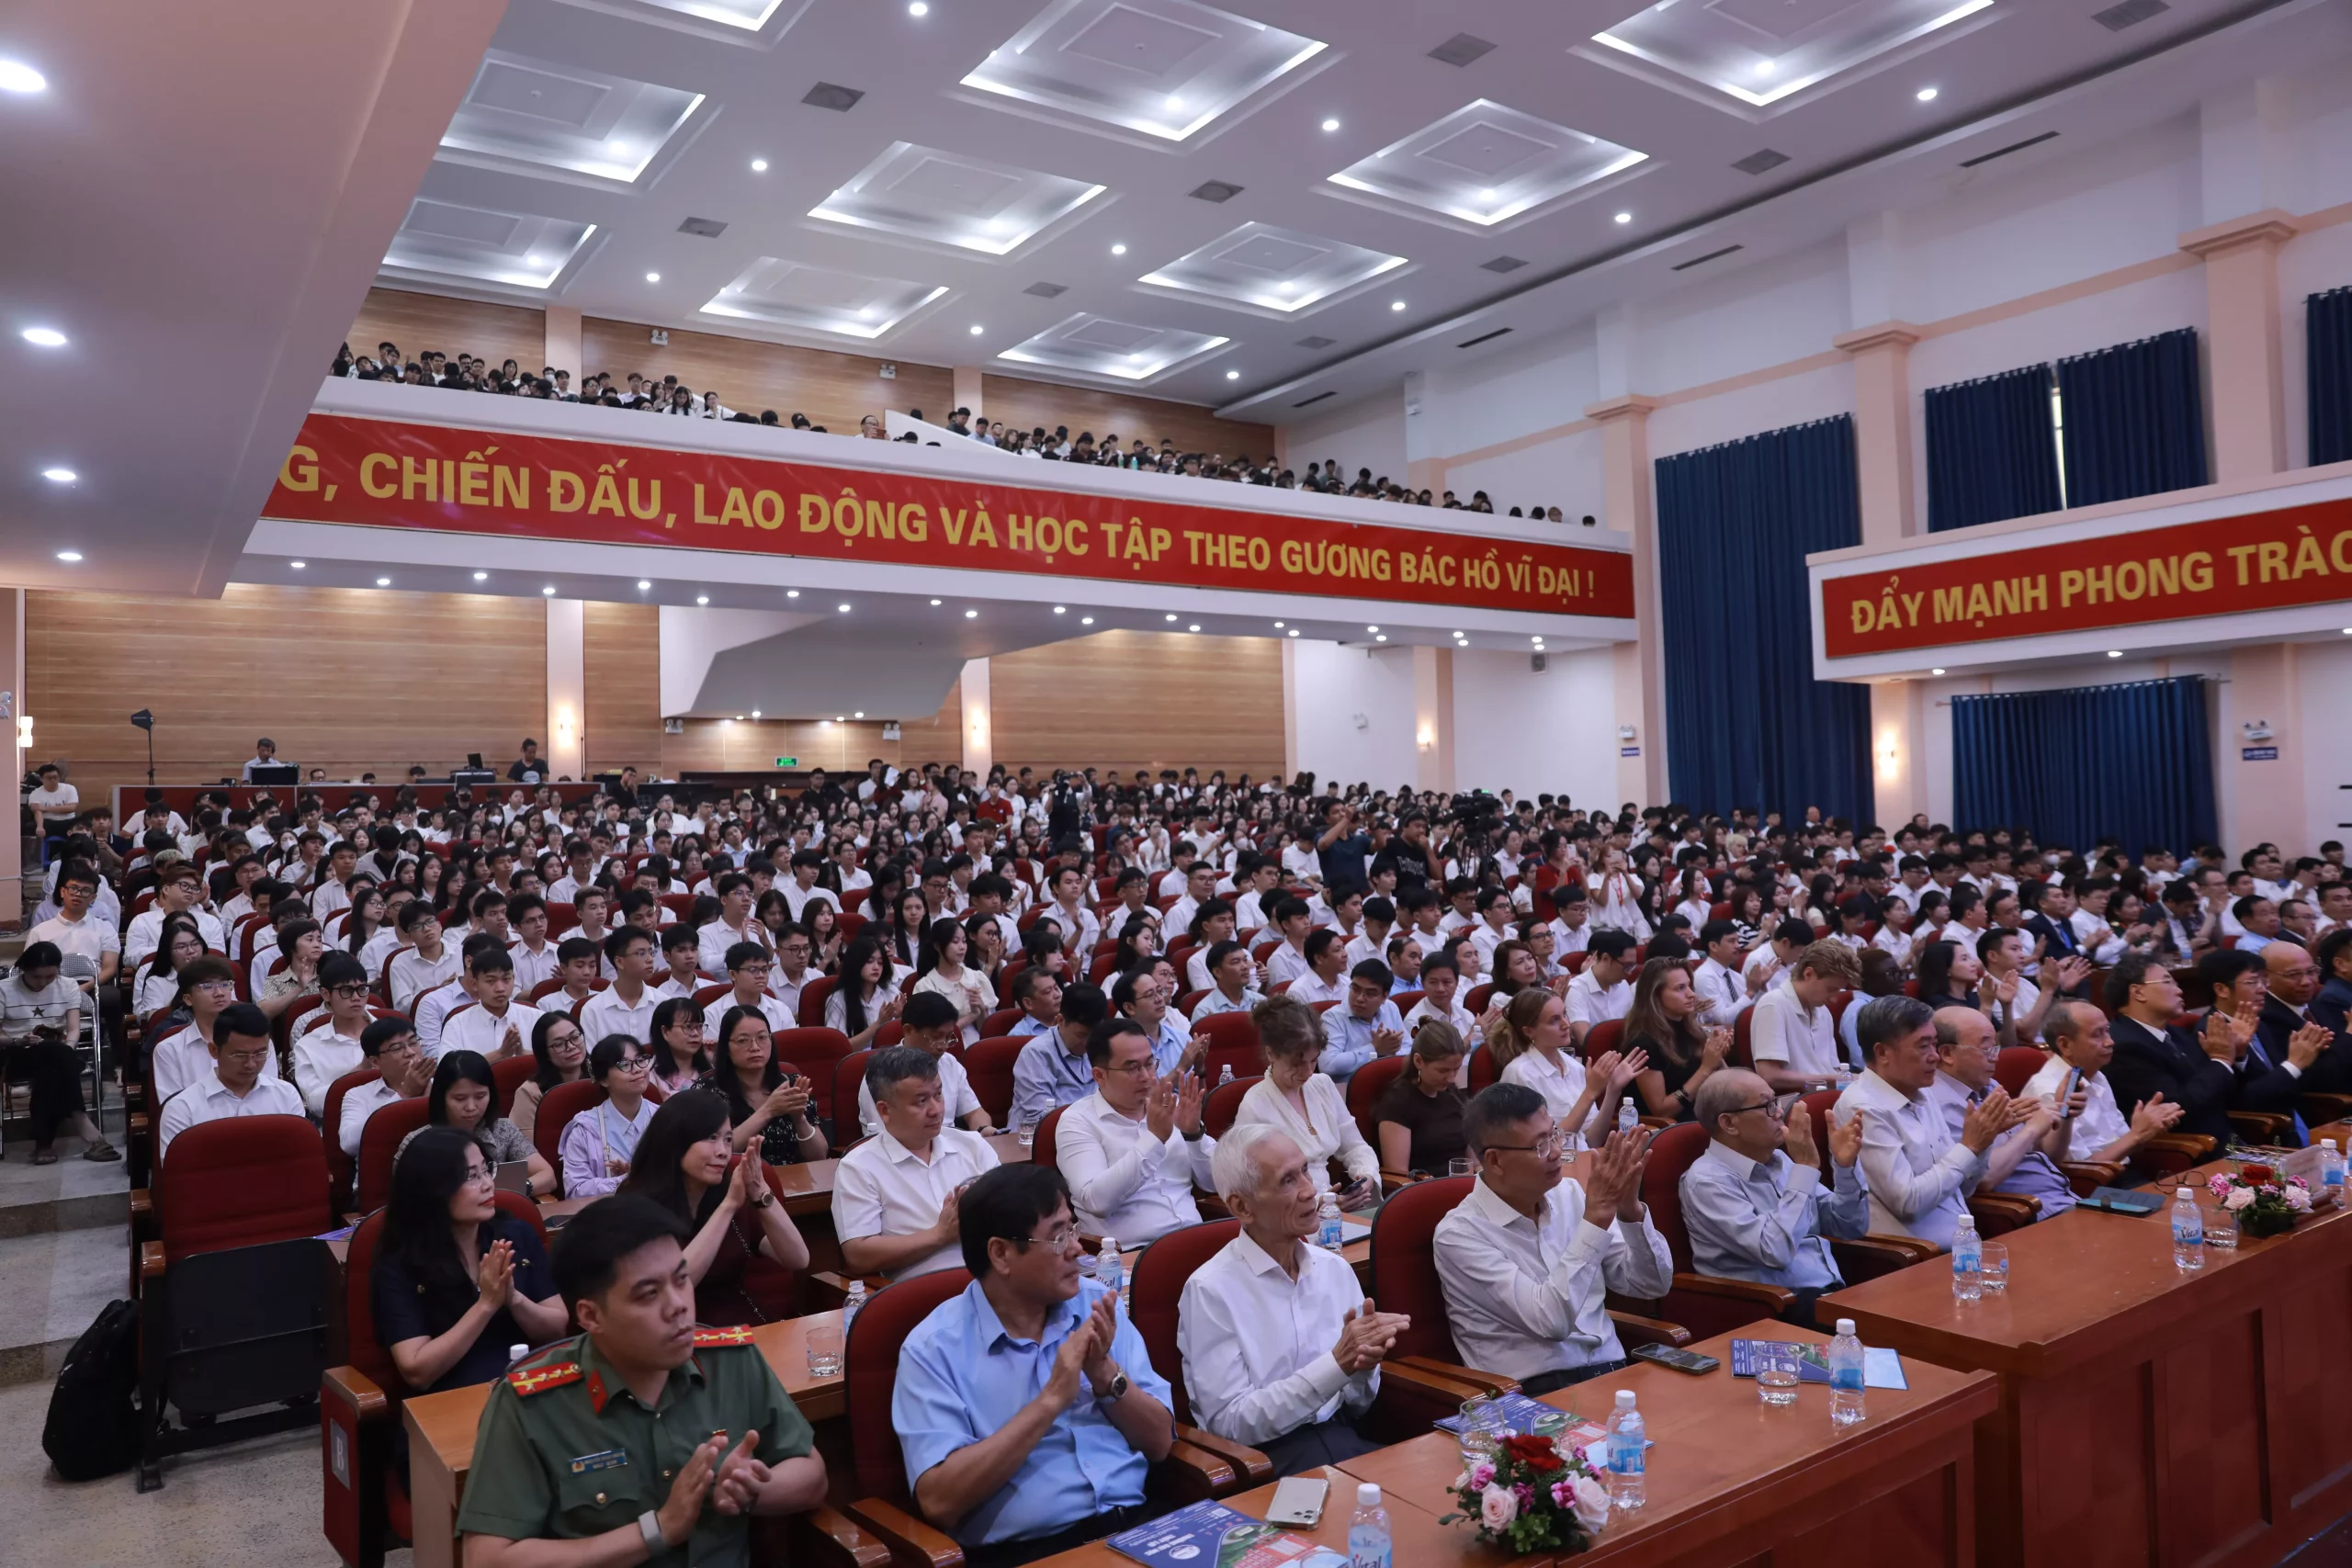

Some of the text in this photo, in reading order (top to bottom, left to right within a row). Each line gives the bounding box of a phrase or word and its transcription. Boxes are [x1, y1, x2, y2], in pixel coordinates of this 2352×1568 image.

[360, 446, 529, 509] CHIẾN
[547, 459, 677, 528] ĐẤU,
[695, 483, 785, 529] LAO
[797, 487, 928, 547] ĐỘNG
[940, 500, 999, 548] VÀ
[1009, 513, 1090, 564] HỌC
[1100, 516, 1172, 570] TẬP
[1183, 530, 1272, 571] THEO
[1280, 540, 1392, 581] GƯƠNG
[1399, 546, 1457, 587] BÁC
[1463, 547, 1501, 591] HỒ
[1505, 554, 1532, 592] VĨ
[1537, 565, 1580, 604] ĐẠI
[1587, 570, 1595, 598] !
[1850, 575, 1926, 634] ĐẨY
[1932, 574, 2049, 628] MẠNH
[2060, 551, 2215, 608] PHONG
[336, 1436, 345, 1472] B
